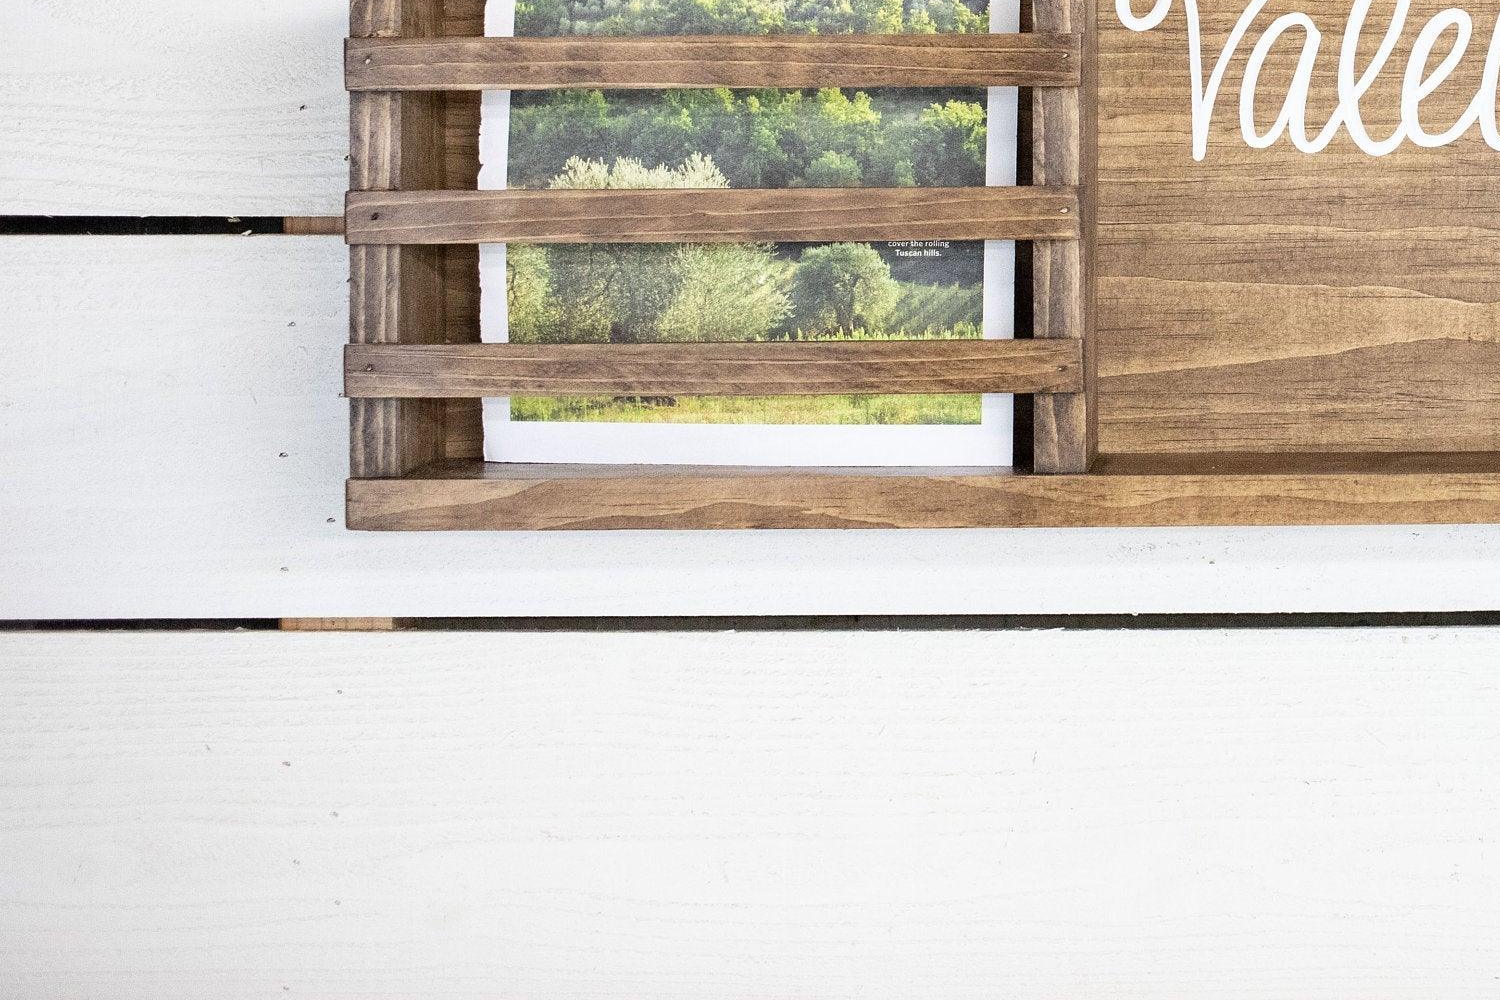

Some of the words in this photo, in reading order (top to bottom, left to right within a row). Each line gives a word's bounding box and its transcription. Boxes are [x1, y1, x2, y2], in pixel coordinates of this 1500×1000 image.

[925, 240, 950, 249] rolling
[895, 249, 922, 257] Tuscan
[923, 249, 942, 257] hills.
